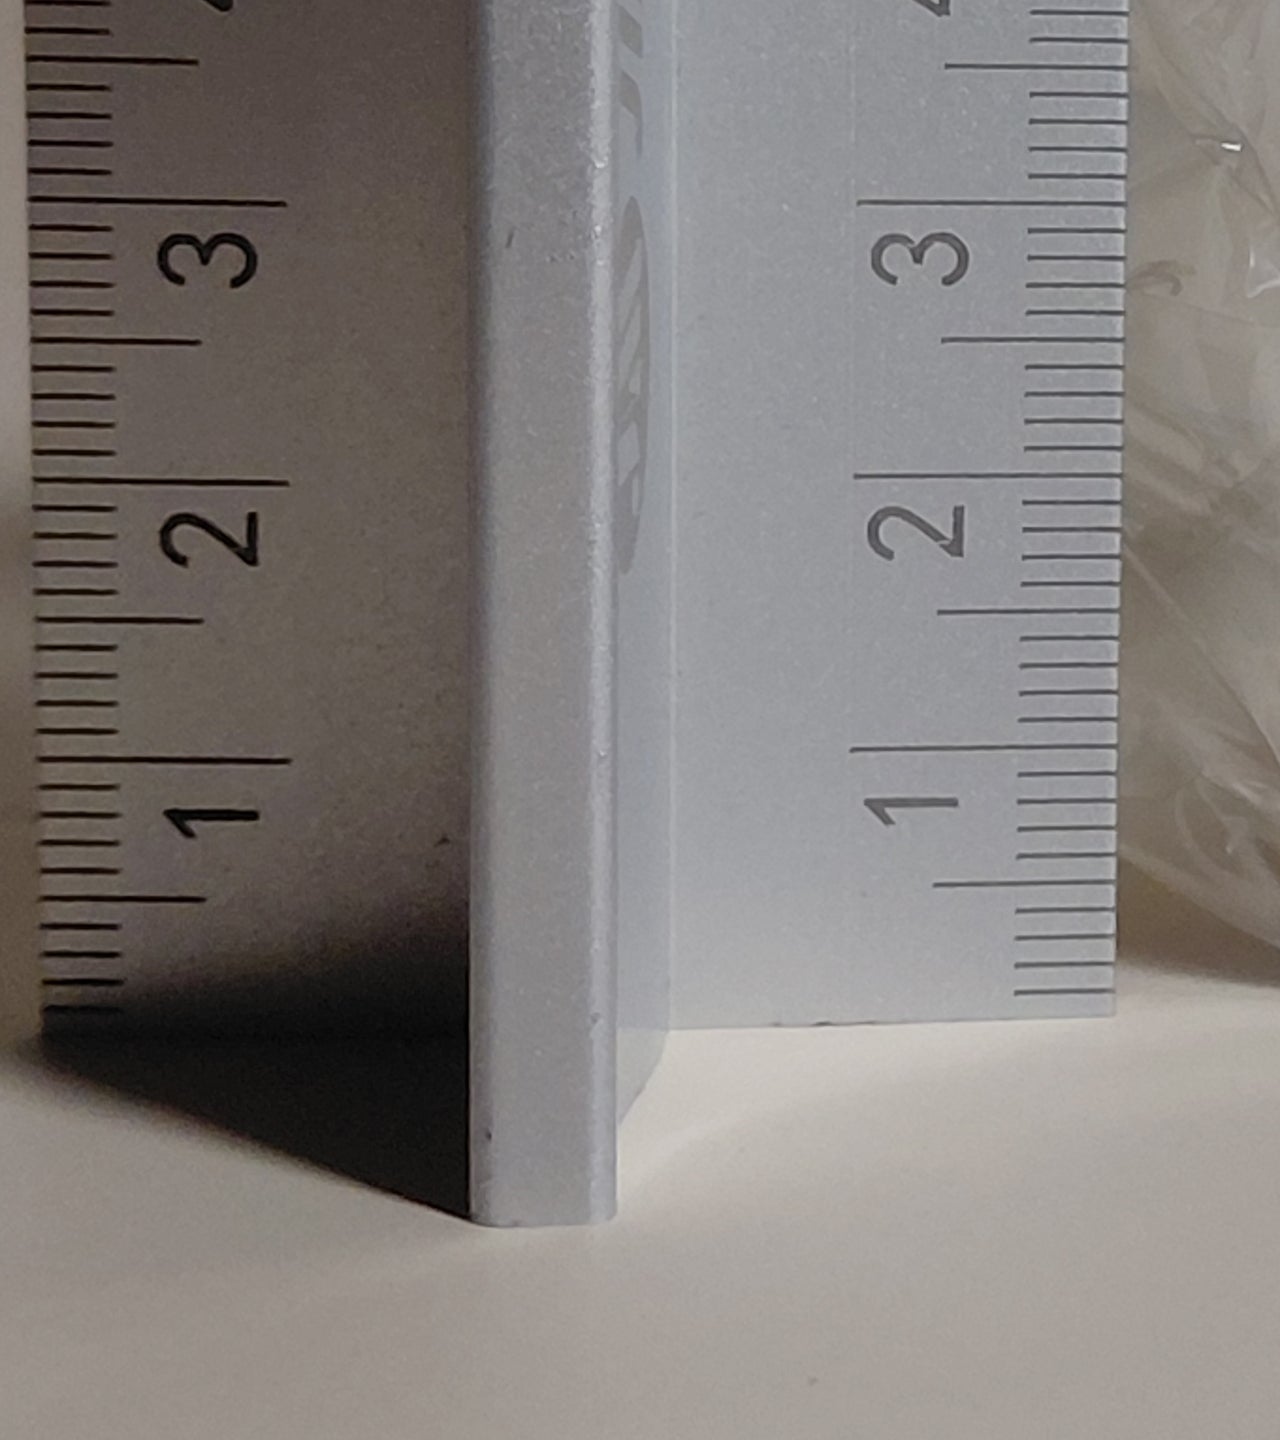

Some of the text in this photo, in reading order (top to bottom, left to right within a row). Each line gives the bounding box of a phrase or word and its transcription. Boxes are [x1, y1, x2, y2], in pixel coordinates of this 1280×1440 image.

[156, 232, 258, 289] 3
[871, 232, 970, 287] 3
[158, 511, 259, 567] 2
[866, 505, 965, 561] 2
[163, 808, 260, 839] 1
[863, 797, 959, 826] 1
